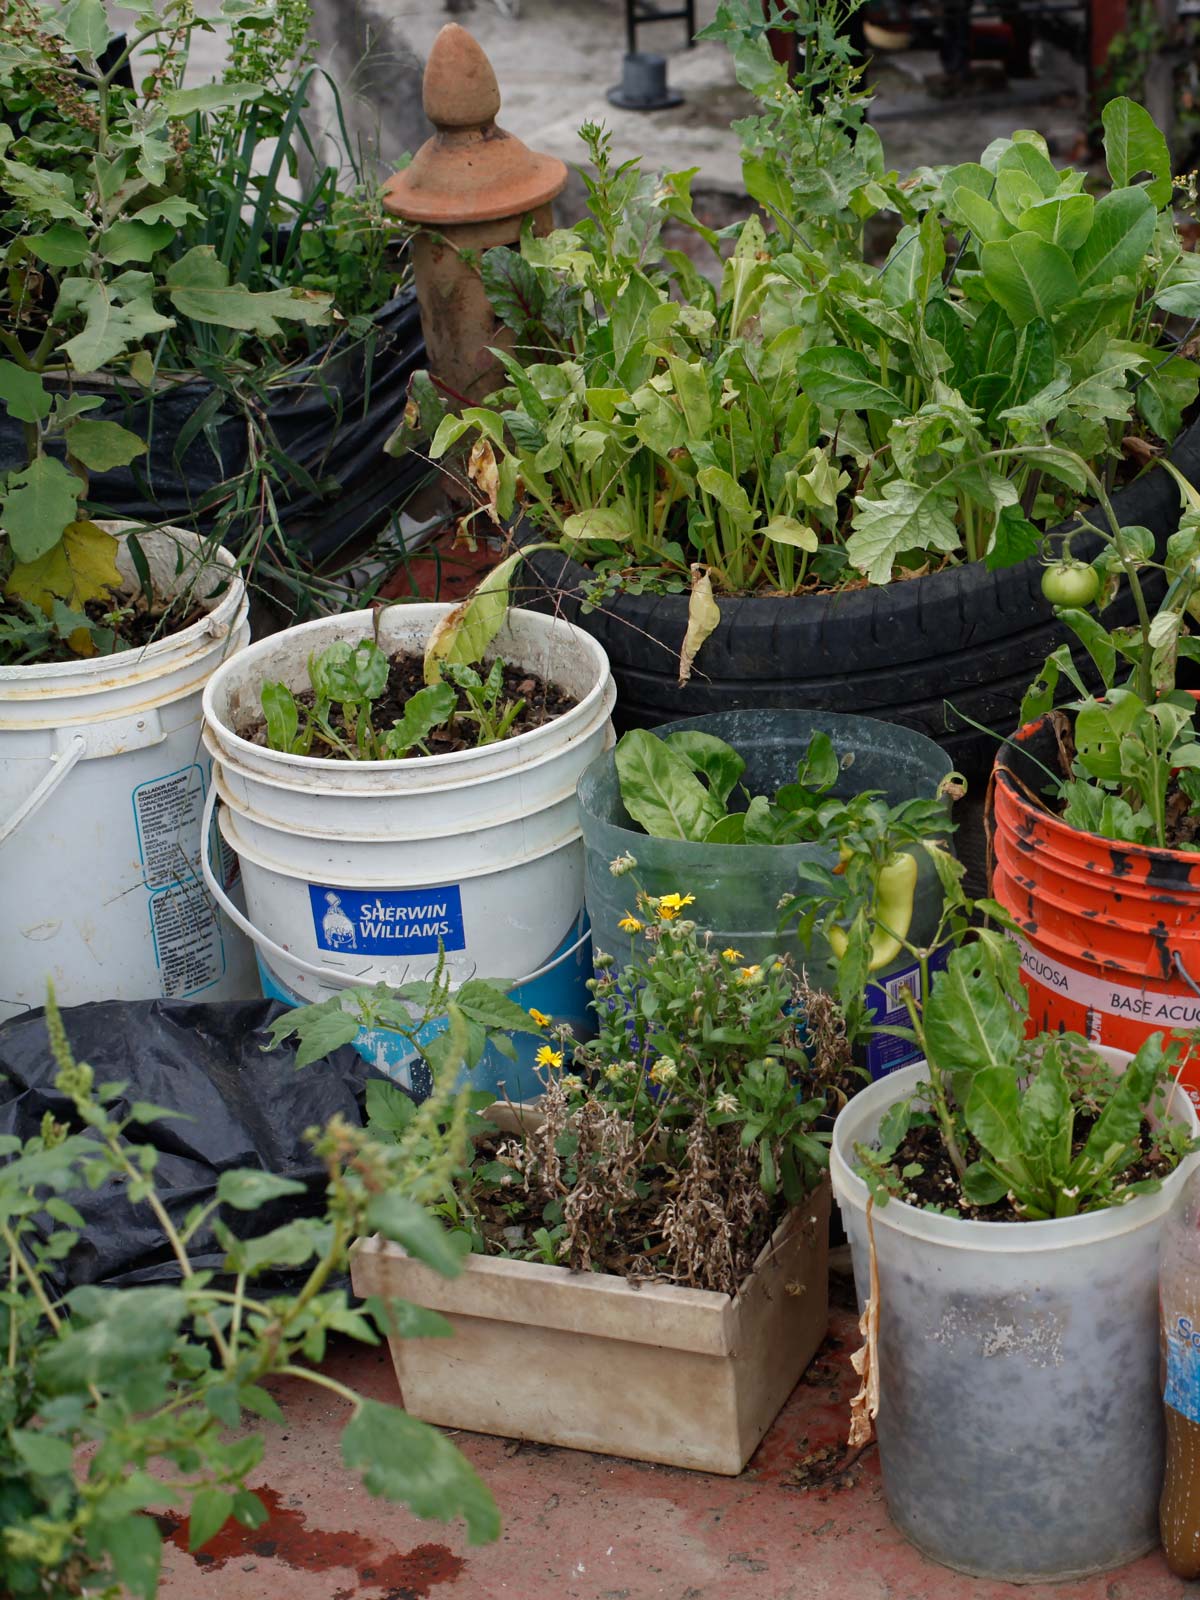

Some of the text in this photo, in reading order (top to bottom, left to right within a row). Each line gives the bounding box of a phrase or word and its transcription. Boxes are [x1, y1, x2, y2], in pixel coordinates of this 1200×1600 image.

[360, 902, 446, 922] SHERWIN
[360, 922, 449, 941] WILLIAMS
[1022, 951, 1068, 990] ACUOSA
[1111, 993, 1152, 1016] BASE
